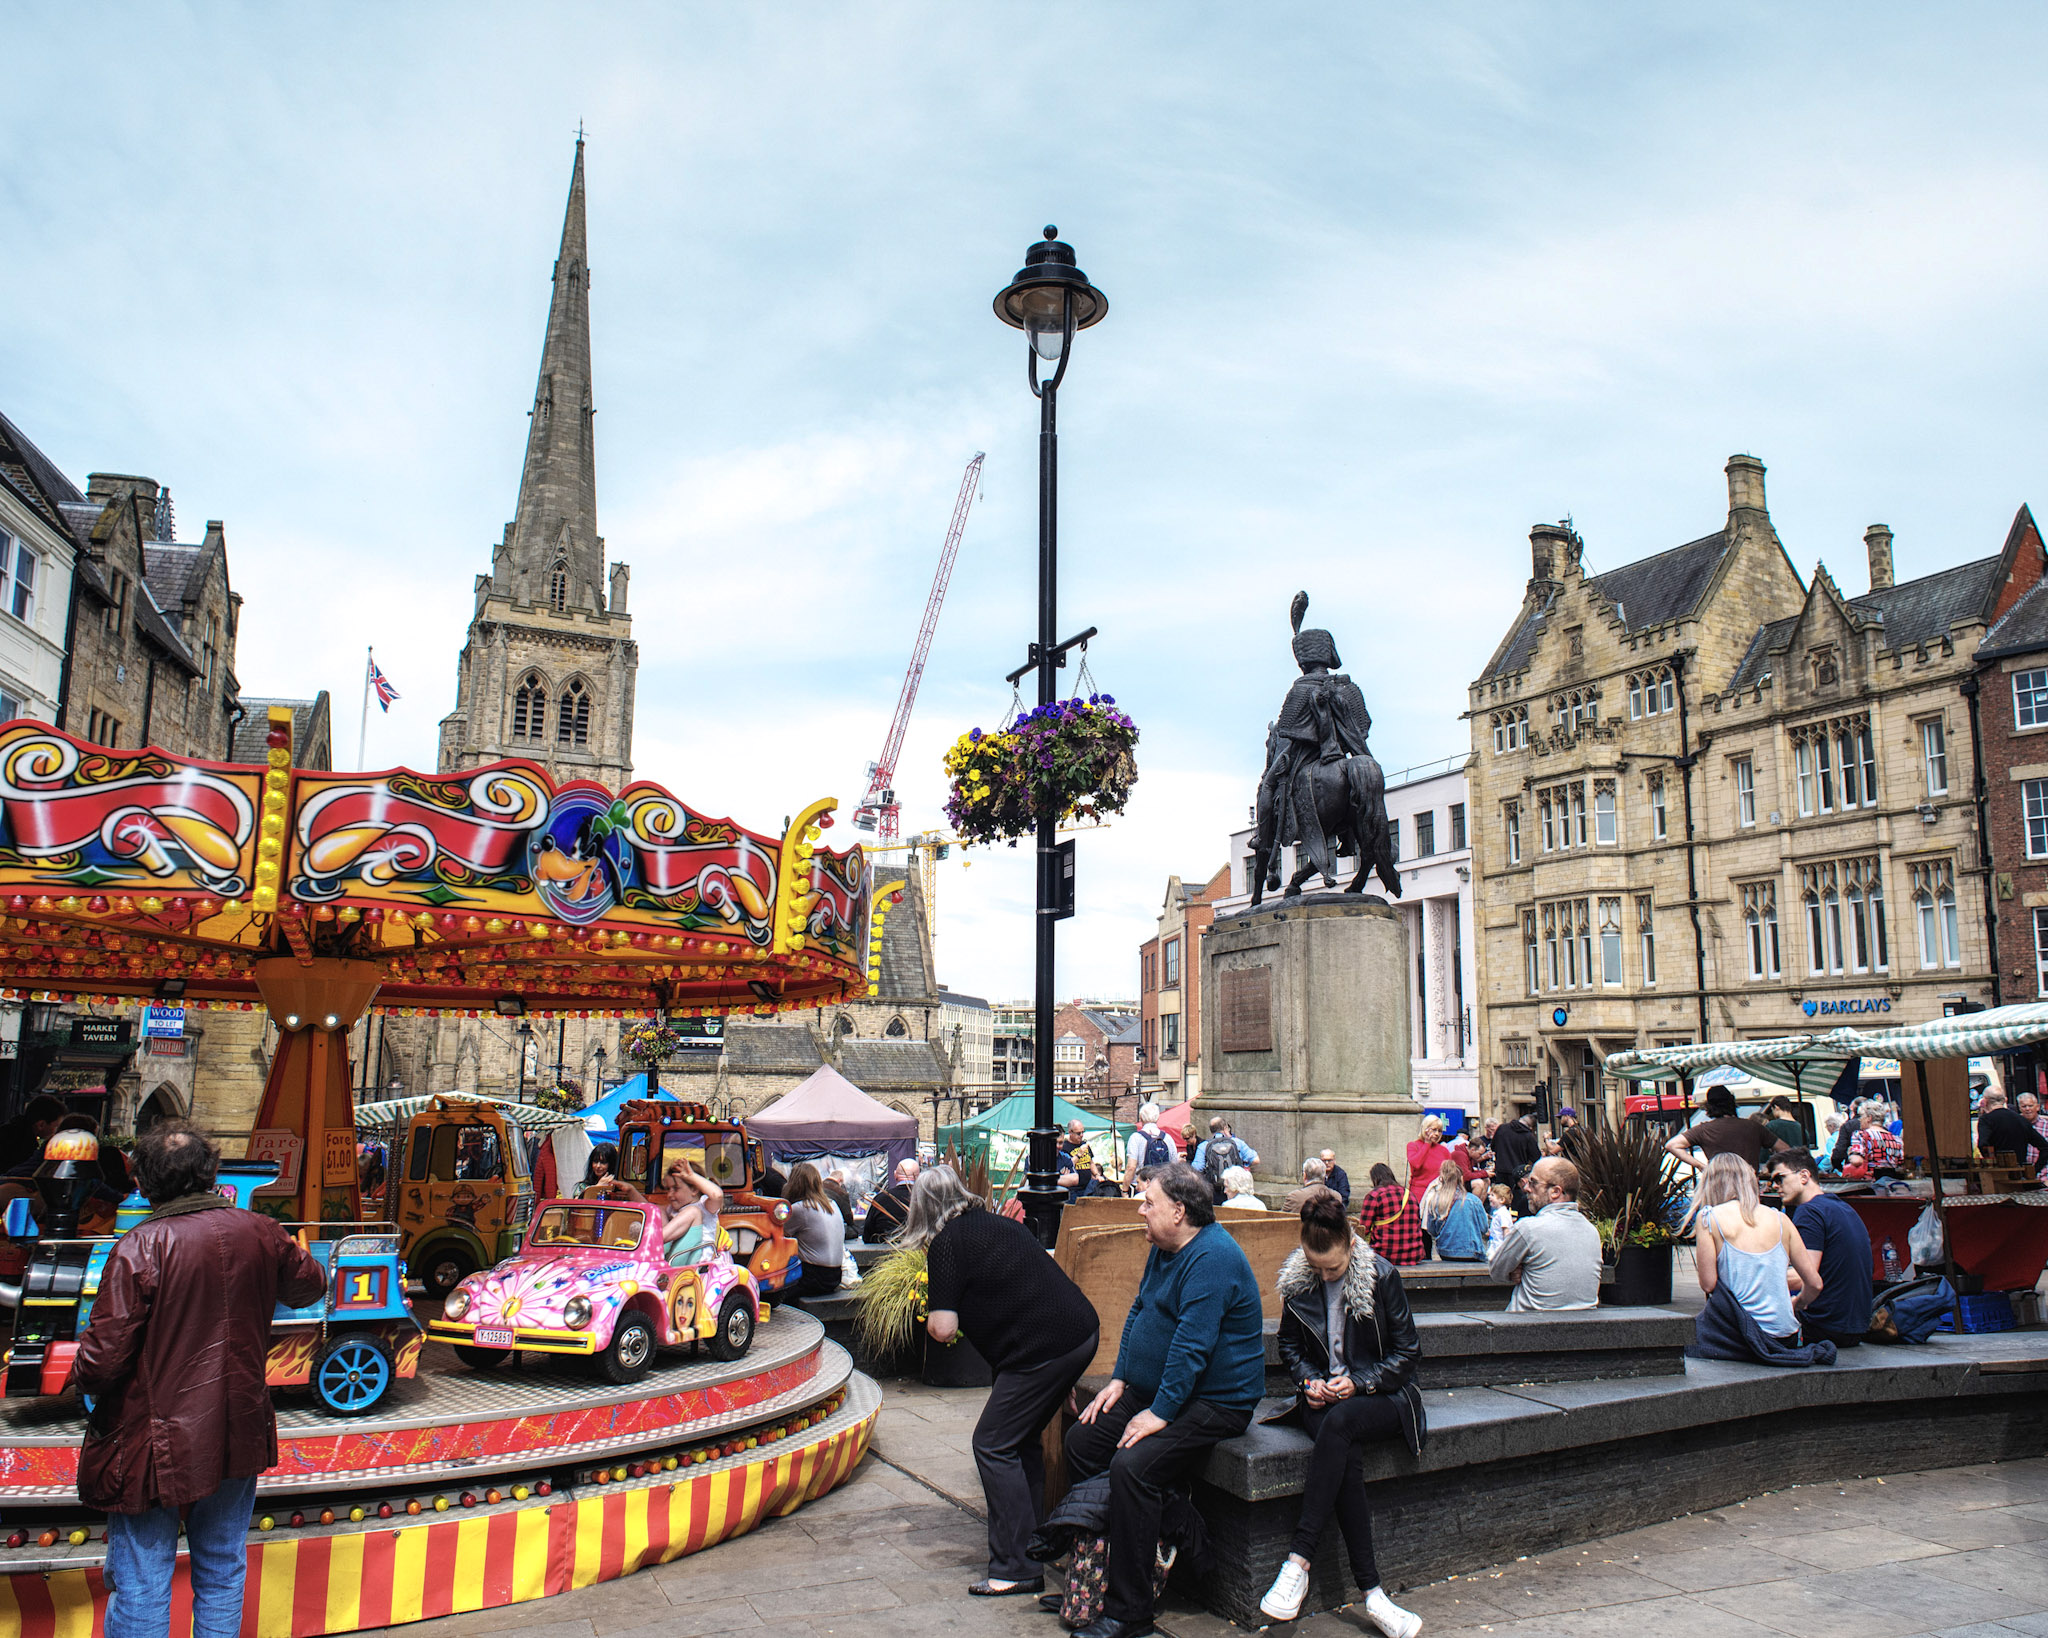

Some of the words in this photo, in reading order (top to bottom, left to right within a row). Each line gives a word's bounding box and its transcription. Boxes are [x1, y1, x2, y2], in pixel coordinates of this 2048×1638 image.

[152, 1008, 184, 1018] WOOD
[1820, 998, 1891, 1014] BARCLAYS
[256, 1136, 298, 1148] fare
[327, 1150, 351, 1168] £1.00
[579, 1262, 635, 1281] Barbie
[353, 1272, 374, 1301] 1
